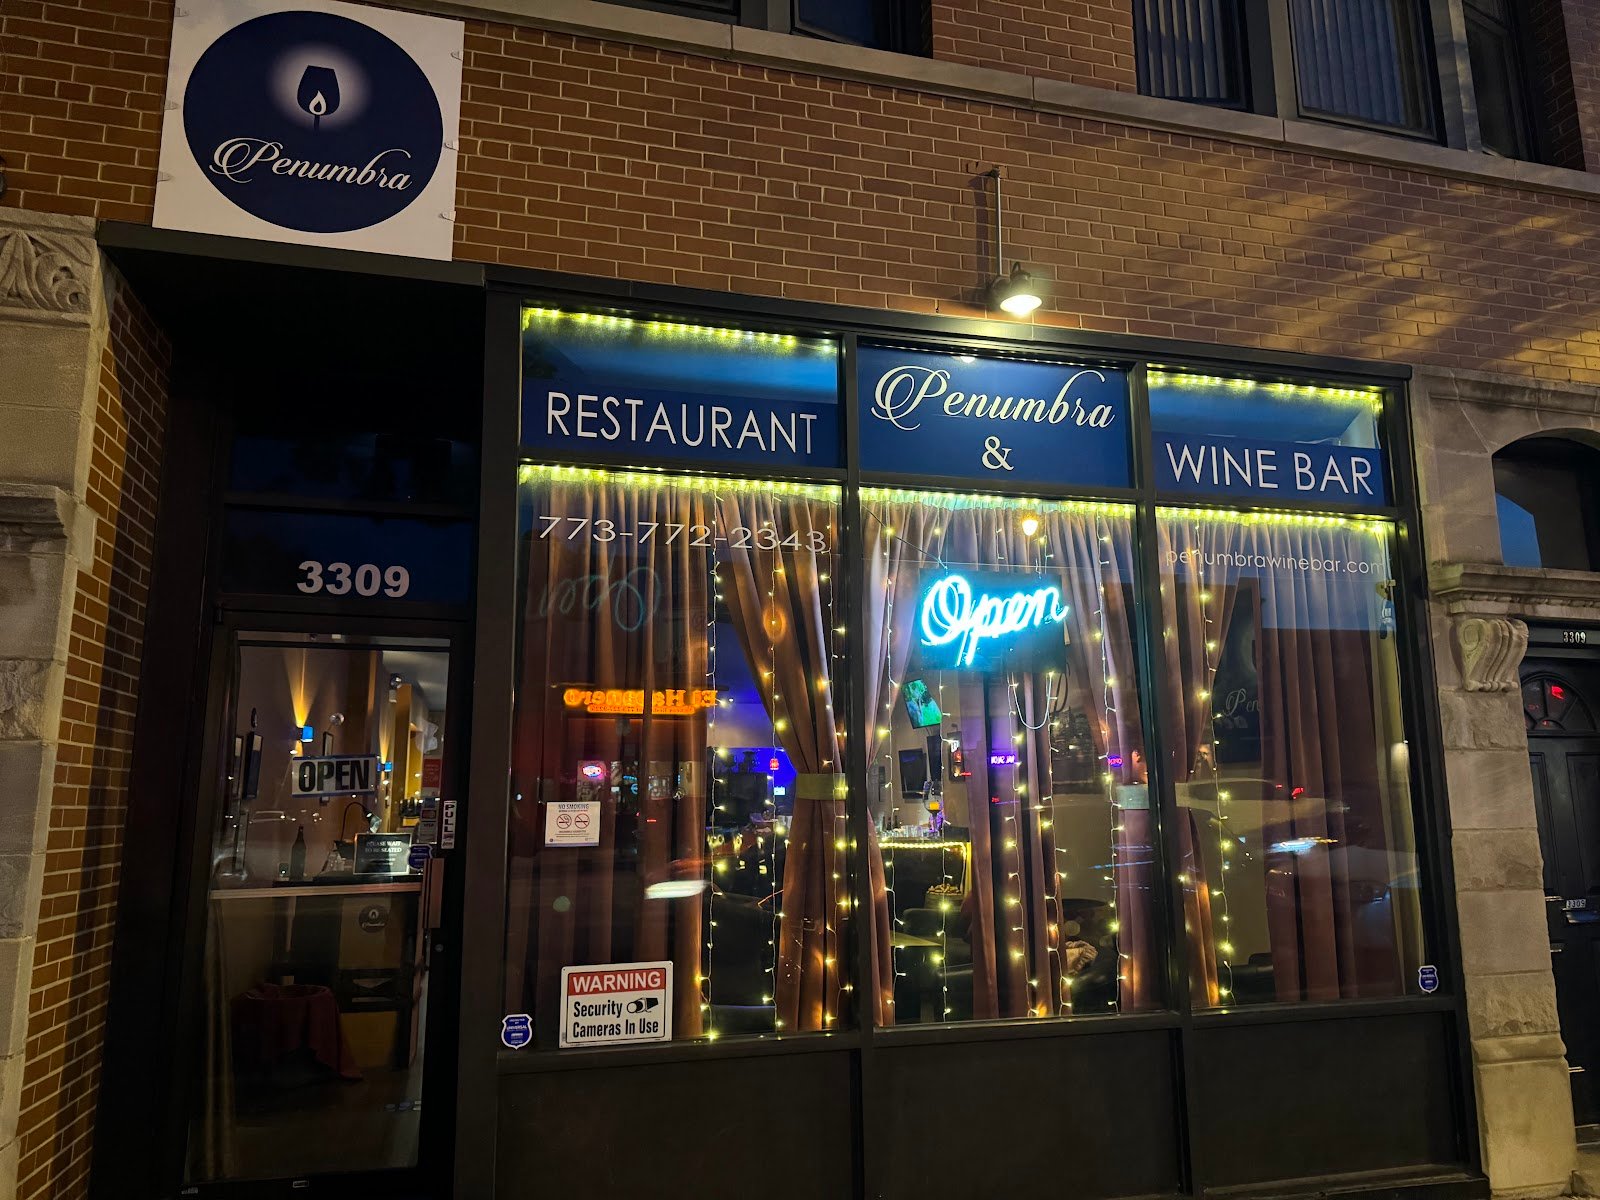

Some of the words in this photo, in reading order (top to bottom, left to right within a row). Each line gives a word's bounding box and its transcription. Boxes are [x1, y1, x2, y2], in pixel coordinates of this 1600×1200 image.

[209, 137, 412, 190] Penumbra
[871, 366, 1115, 430] Penumbra
[547, 391, 817, 454] RESTAURANT
[982, 436, 1014, 471] &
[1166, 443, 1278, 489] WINE
[1294, 452, 1373, 495] BAR
[539, 516, 827, 552] 773-772-2343
[297, 561, 409, 597] 3309
[1166, 549, 1384, 574] penumbrawinebar.com
[921, 575, 1069, 666] Open
[1563, 631, 1586, 643] 3309
[298, 760, 370, 793] OPEN
[444, 804, 455, 833] PULL
[573, 971, 661, 993] WARNING
[574, 1000, 622, 1018] Security
[573, 1020, 621, 1038] Cameras
[625, 1018, 636, 1034] In
[639, 1016, 659, 1033] Use
